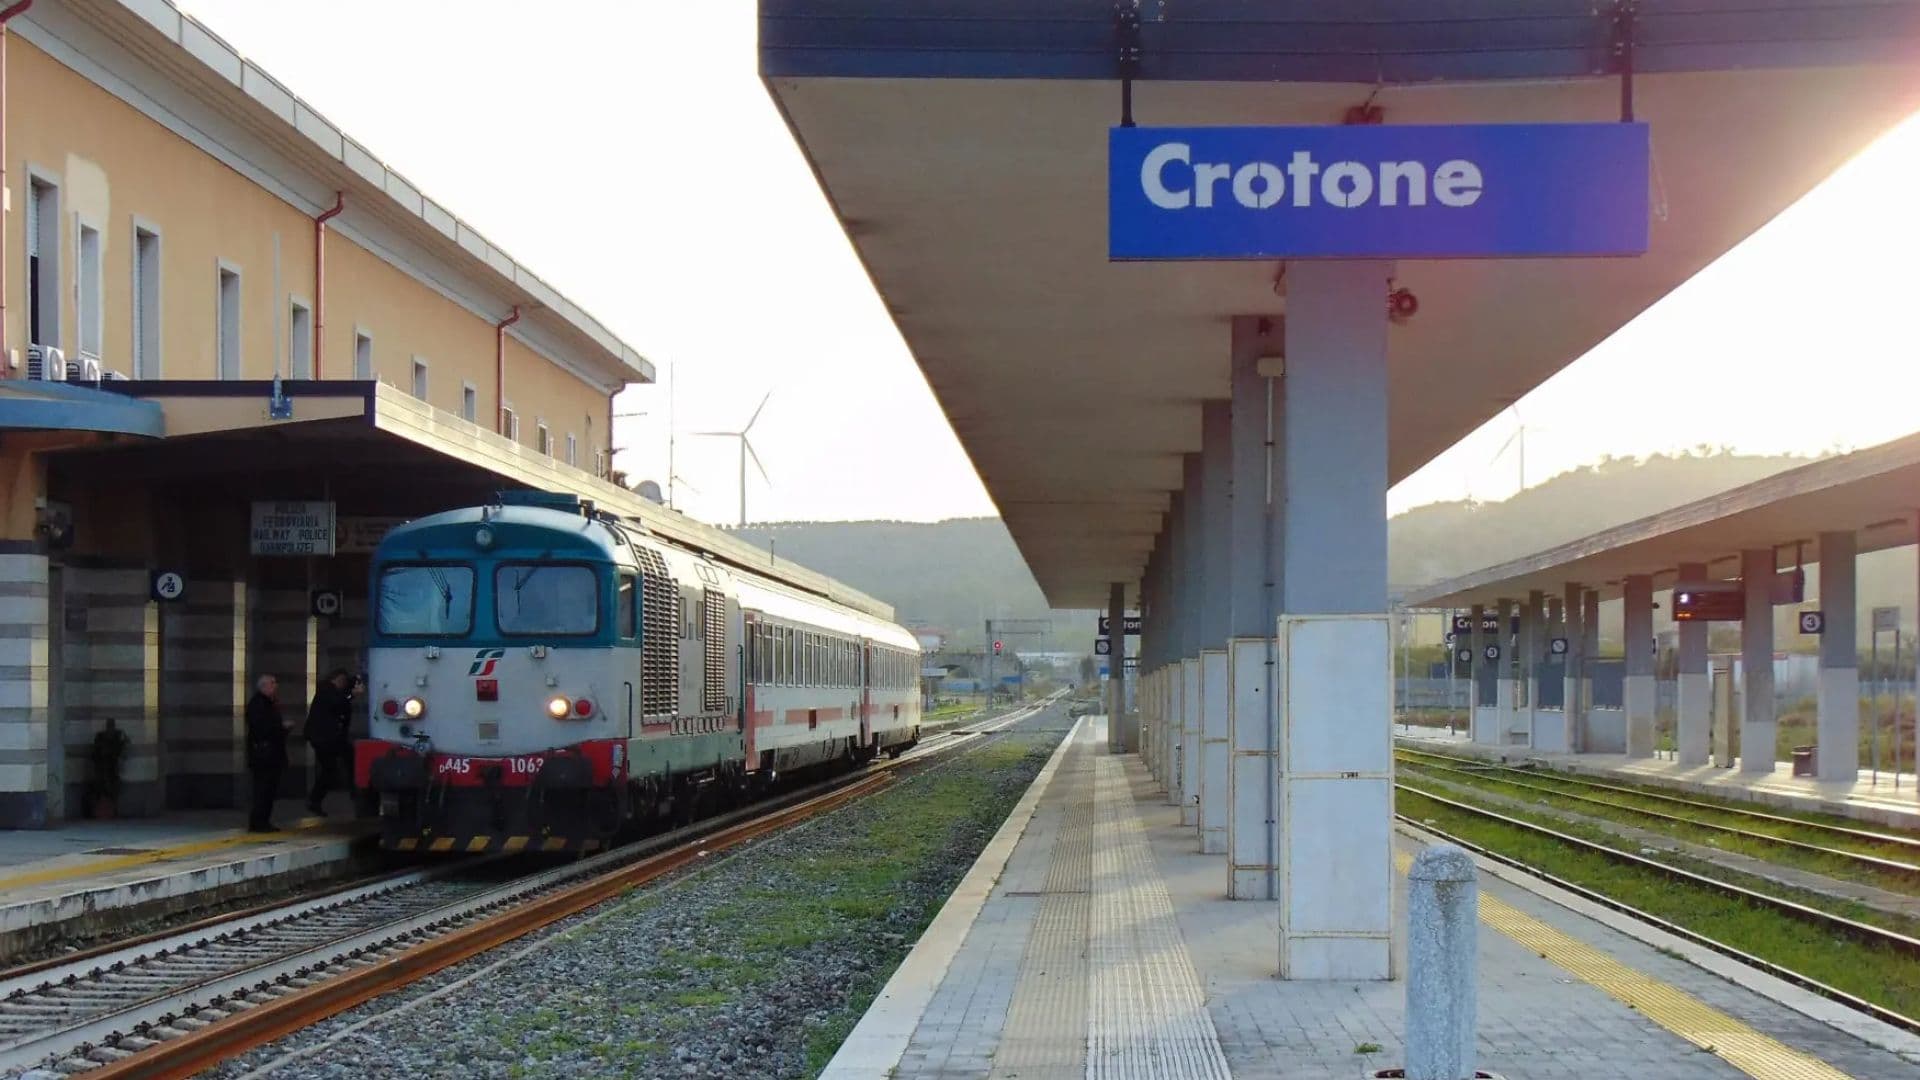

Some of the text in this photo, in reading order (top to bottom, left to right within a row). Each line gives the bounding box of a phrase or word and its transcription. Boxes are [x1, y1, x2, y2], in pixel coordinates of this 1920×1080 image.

[1140, 142, 1484, 209] Crotone
[298, 529, 328, 541] POLICE
[1806, 616, 1816, 628] 3
